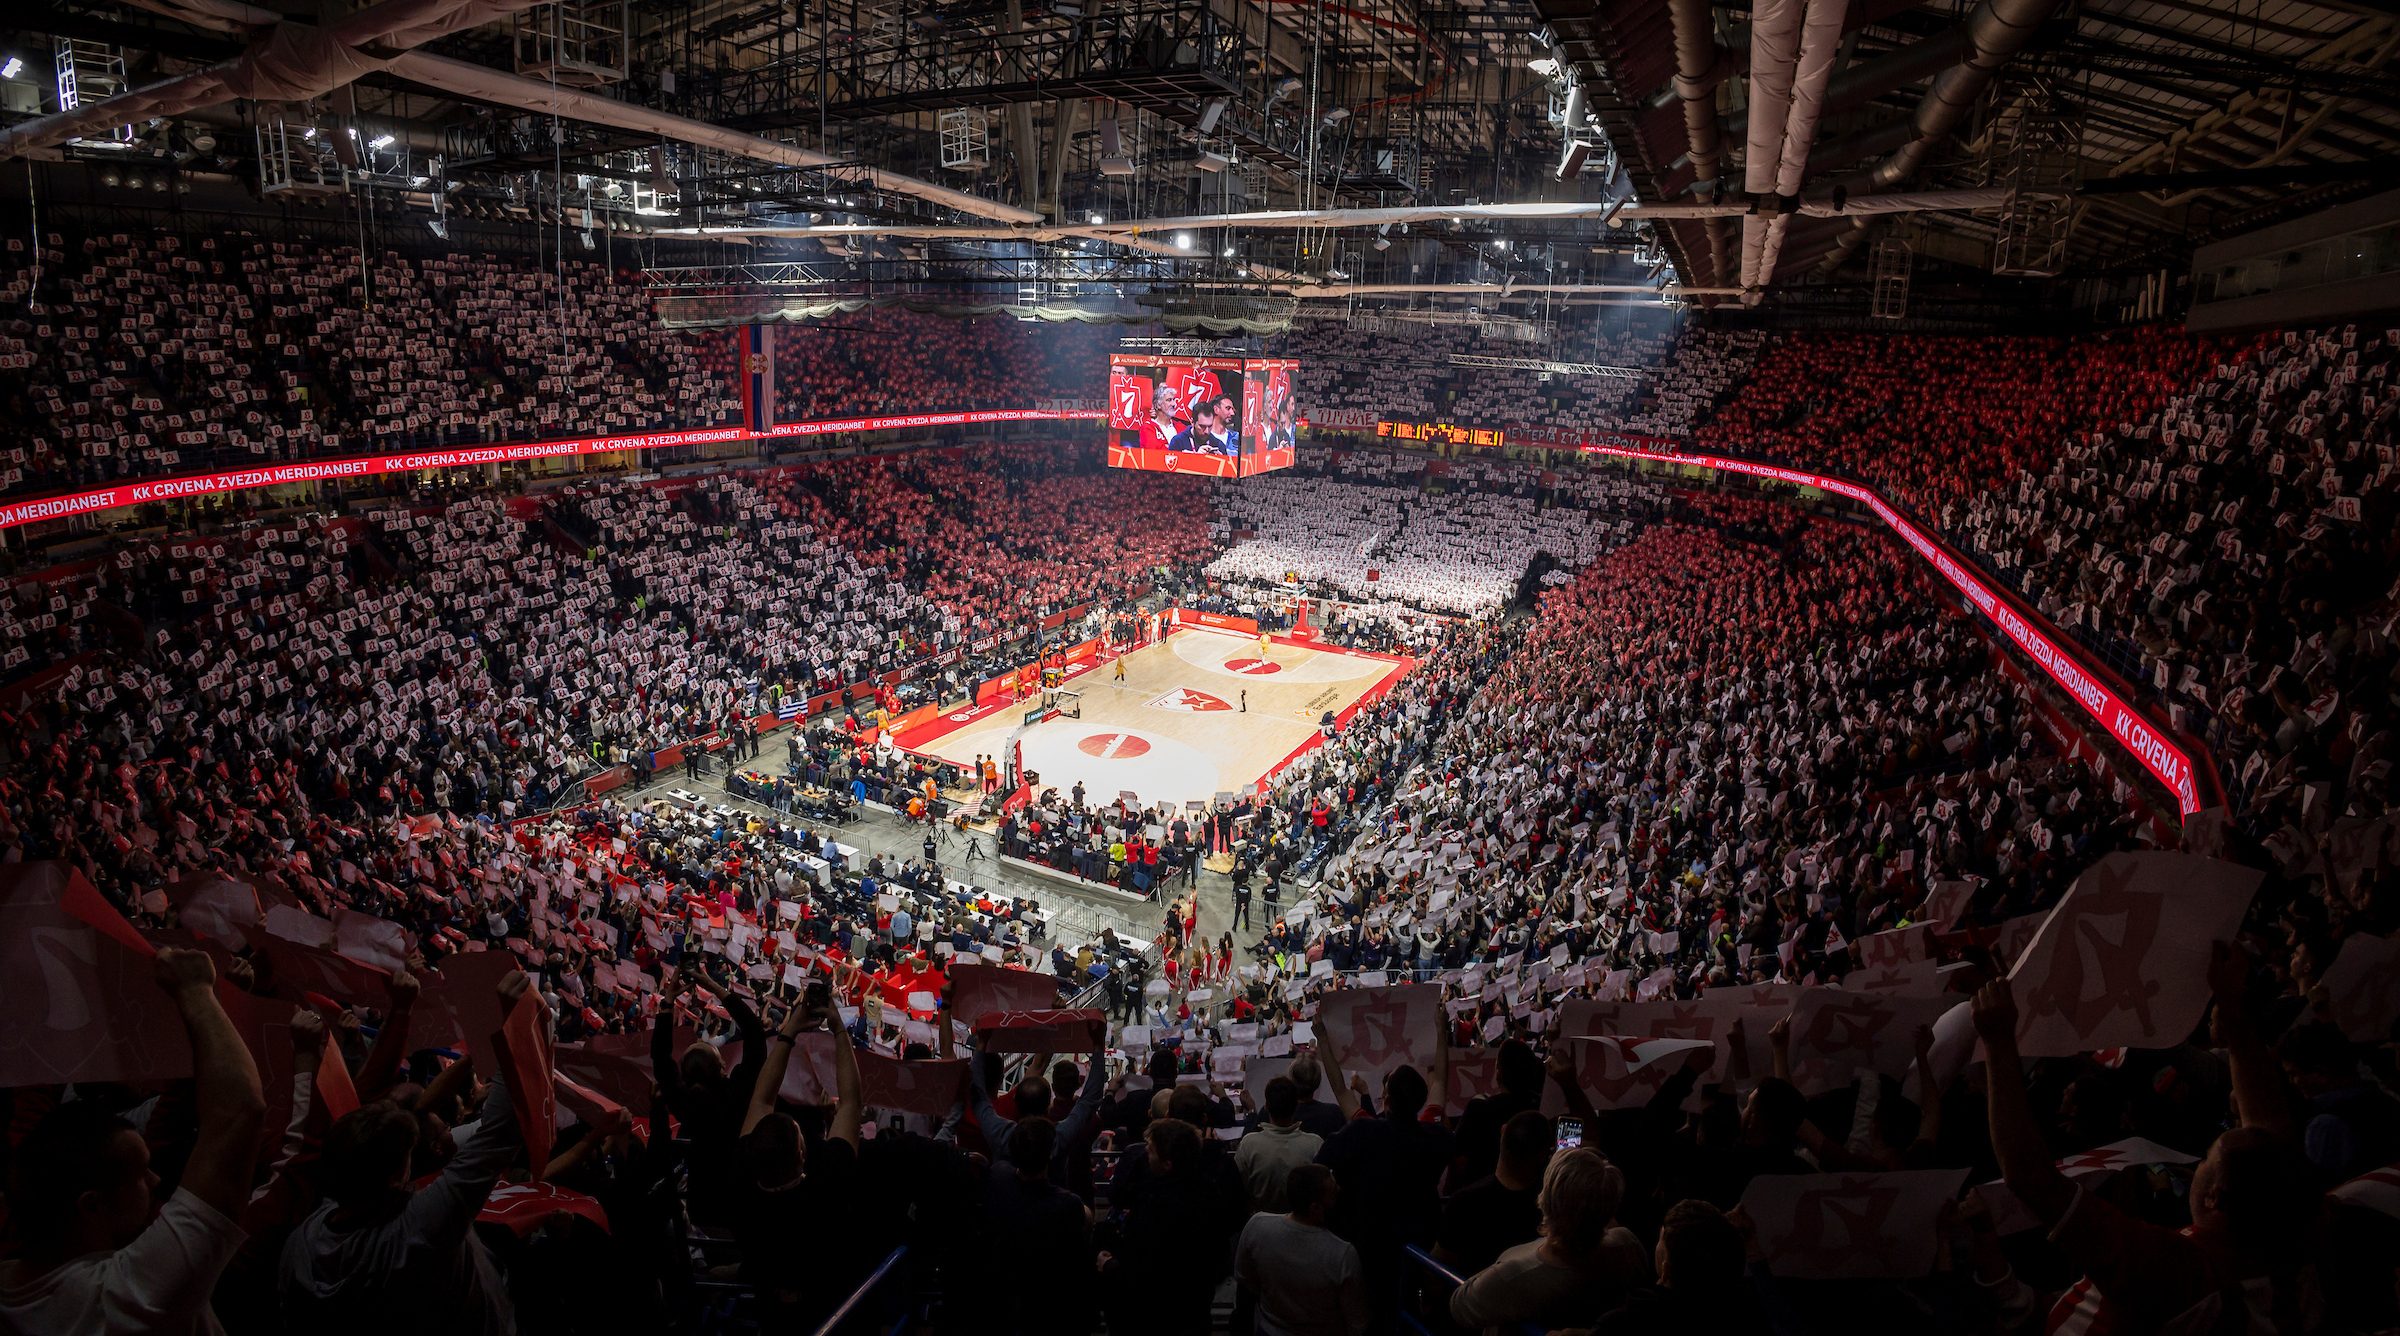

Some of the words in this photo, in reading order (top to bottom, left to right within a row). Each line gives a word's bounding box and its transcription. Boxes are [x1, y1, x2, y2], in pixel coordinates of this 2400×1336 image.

[793, 424, 820, 434] ZVEZDA
[822, 421, 866, 432] MERIDIANBET
[873, 420, 881, 428] KK
[882, 419, 906, 427] CRVENA
[907, 417, 929, 426] ZVEZDA
[930, 414, 965, 424] MERIDIANBET
[592, 441, 606, 451] KK
[607, 437, 646, 450] CRVENA
[648, 435, 683, 447] ZVEZDA
[685, 430, 741, 443] MERIDIANBET
[385, 458, 403, 470] KK
[406, 453, 457, 468] CRVENA
[459, 449, 504, 464] ZVEZDA
[507, 443, 580, 459] MERIDIANBET
[133, 487, 151, 500] KK
[153, 478, 213, 497] CRVENA
[217, 469, 272, 489] ZVEZDA
[274, 461, 369, 481] MERIDIANBET
[1715, 460, 1725, 468] KK
[1726, 461, 1751, 473] CRVENA
[1752, 465, 1778, 478] ZVEZDA
[1779, 470, 1816, 486] MERIDIANBET
[17, 491, 116, 521] MERIDIANBET
[1998, 606, 2008, 626] KK
[2005, 614, 2029, 646] CRVENA
[2027, 631, 2053, 669] ZVEZDA
[2052, 653, 2108, 716] MERIDIANBET
[2115, 709, 2133, 740] KK
[2131, 724, 2178, 785] CRVENA
